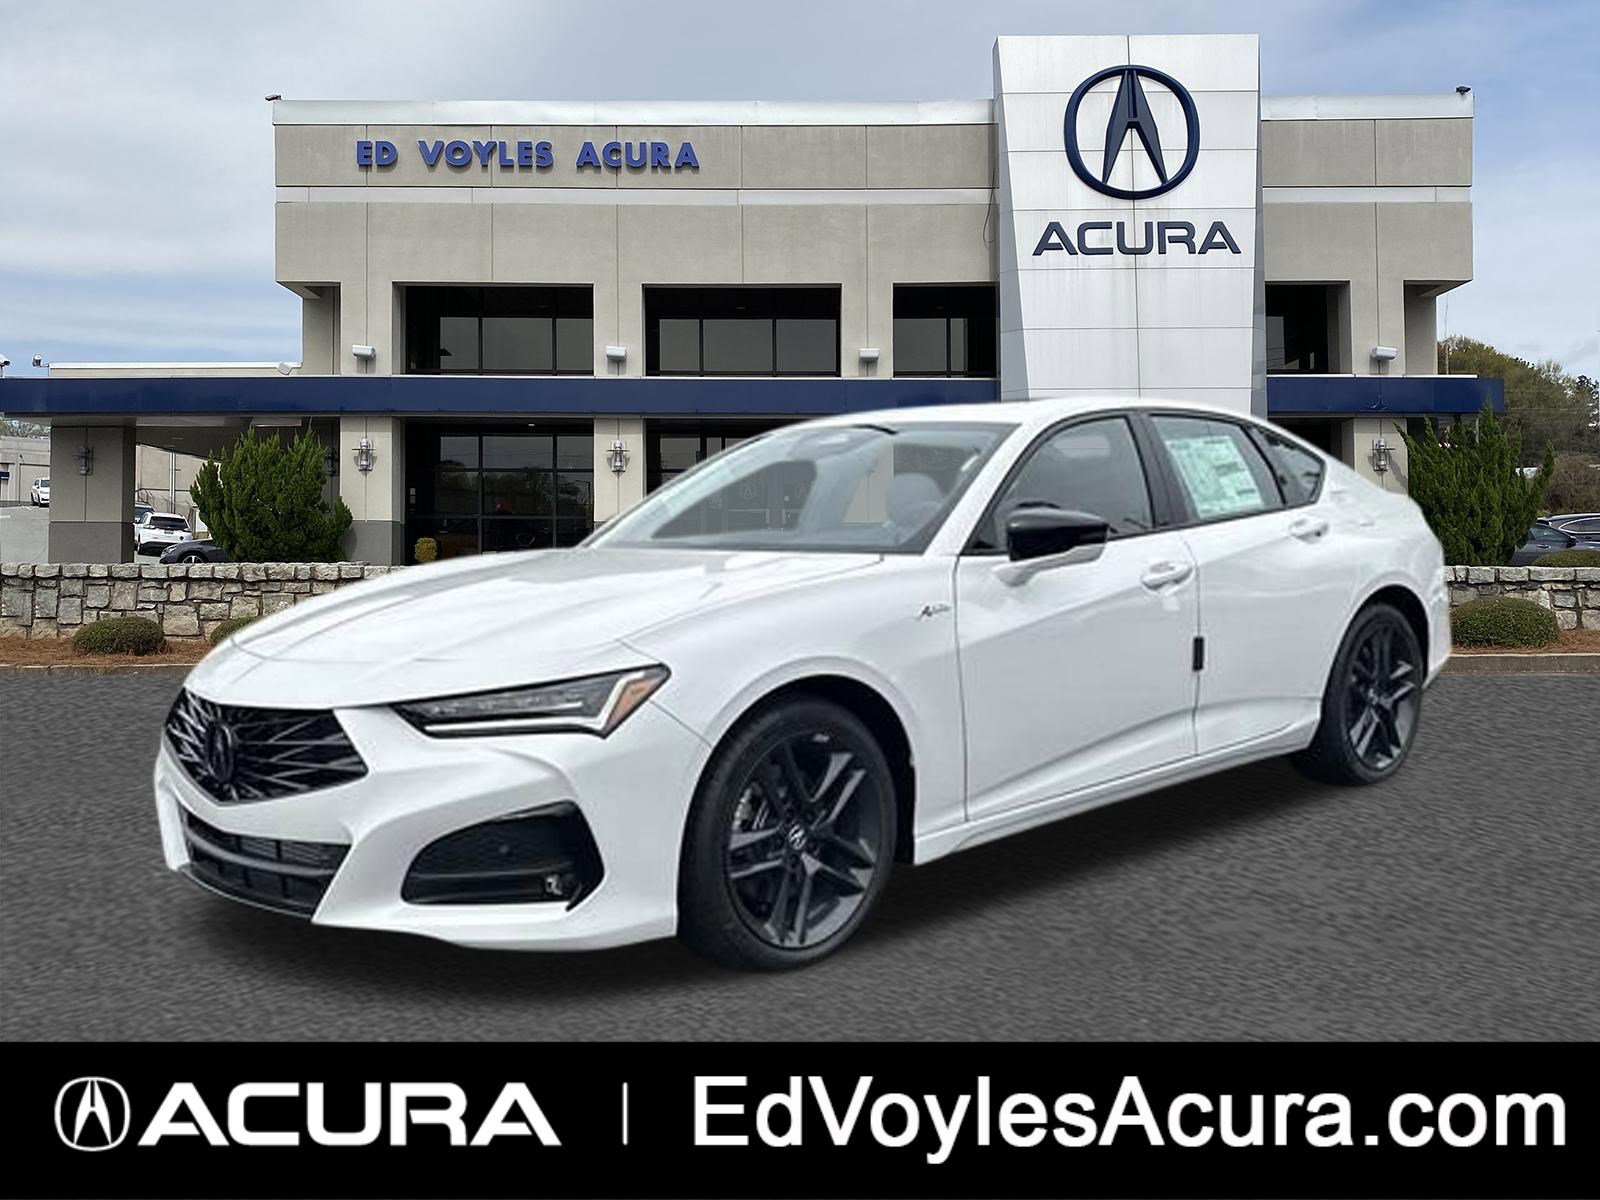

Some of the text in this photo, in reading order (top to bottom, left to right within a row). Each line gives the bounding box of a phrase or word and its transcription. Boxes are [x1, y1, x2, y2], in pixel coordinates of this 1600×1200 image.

[356, 140, 700, 171] ED VOYLES ACURA
[1033, 221, 1242, 256] ACURA
